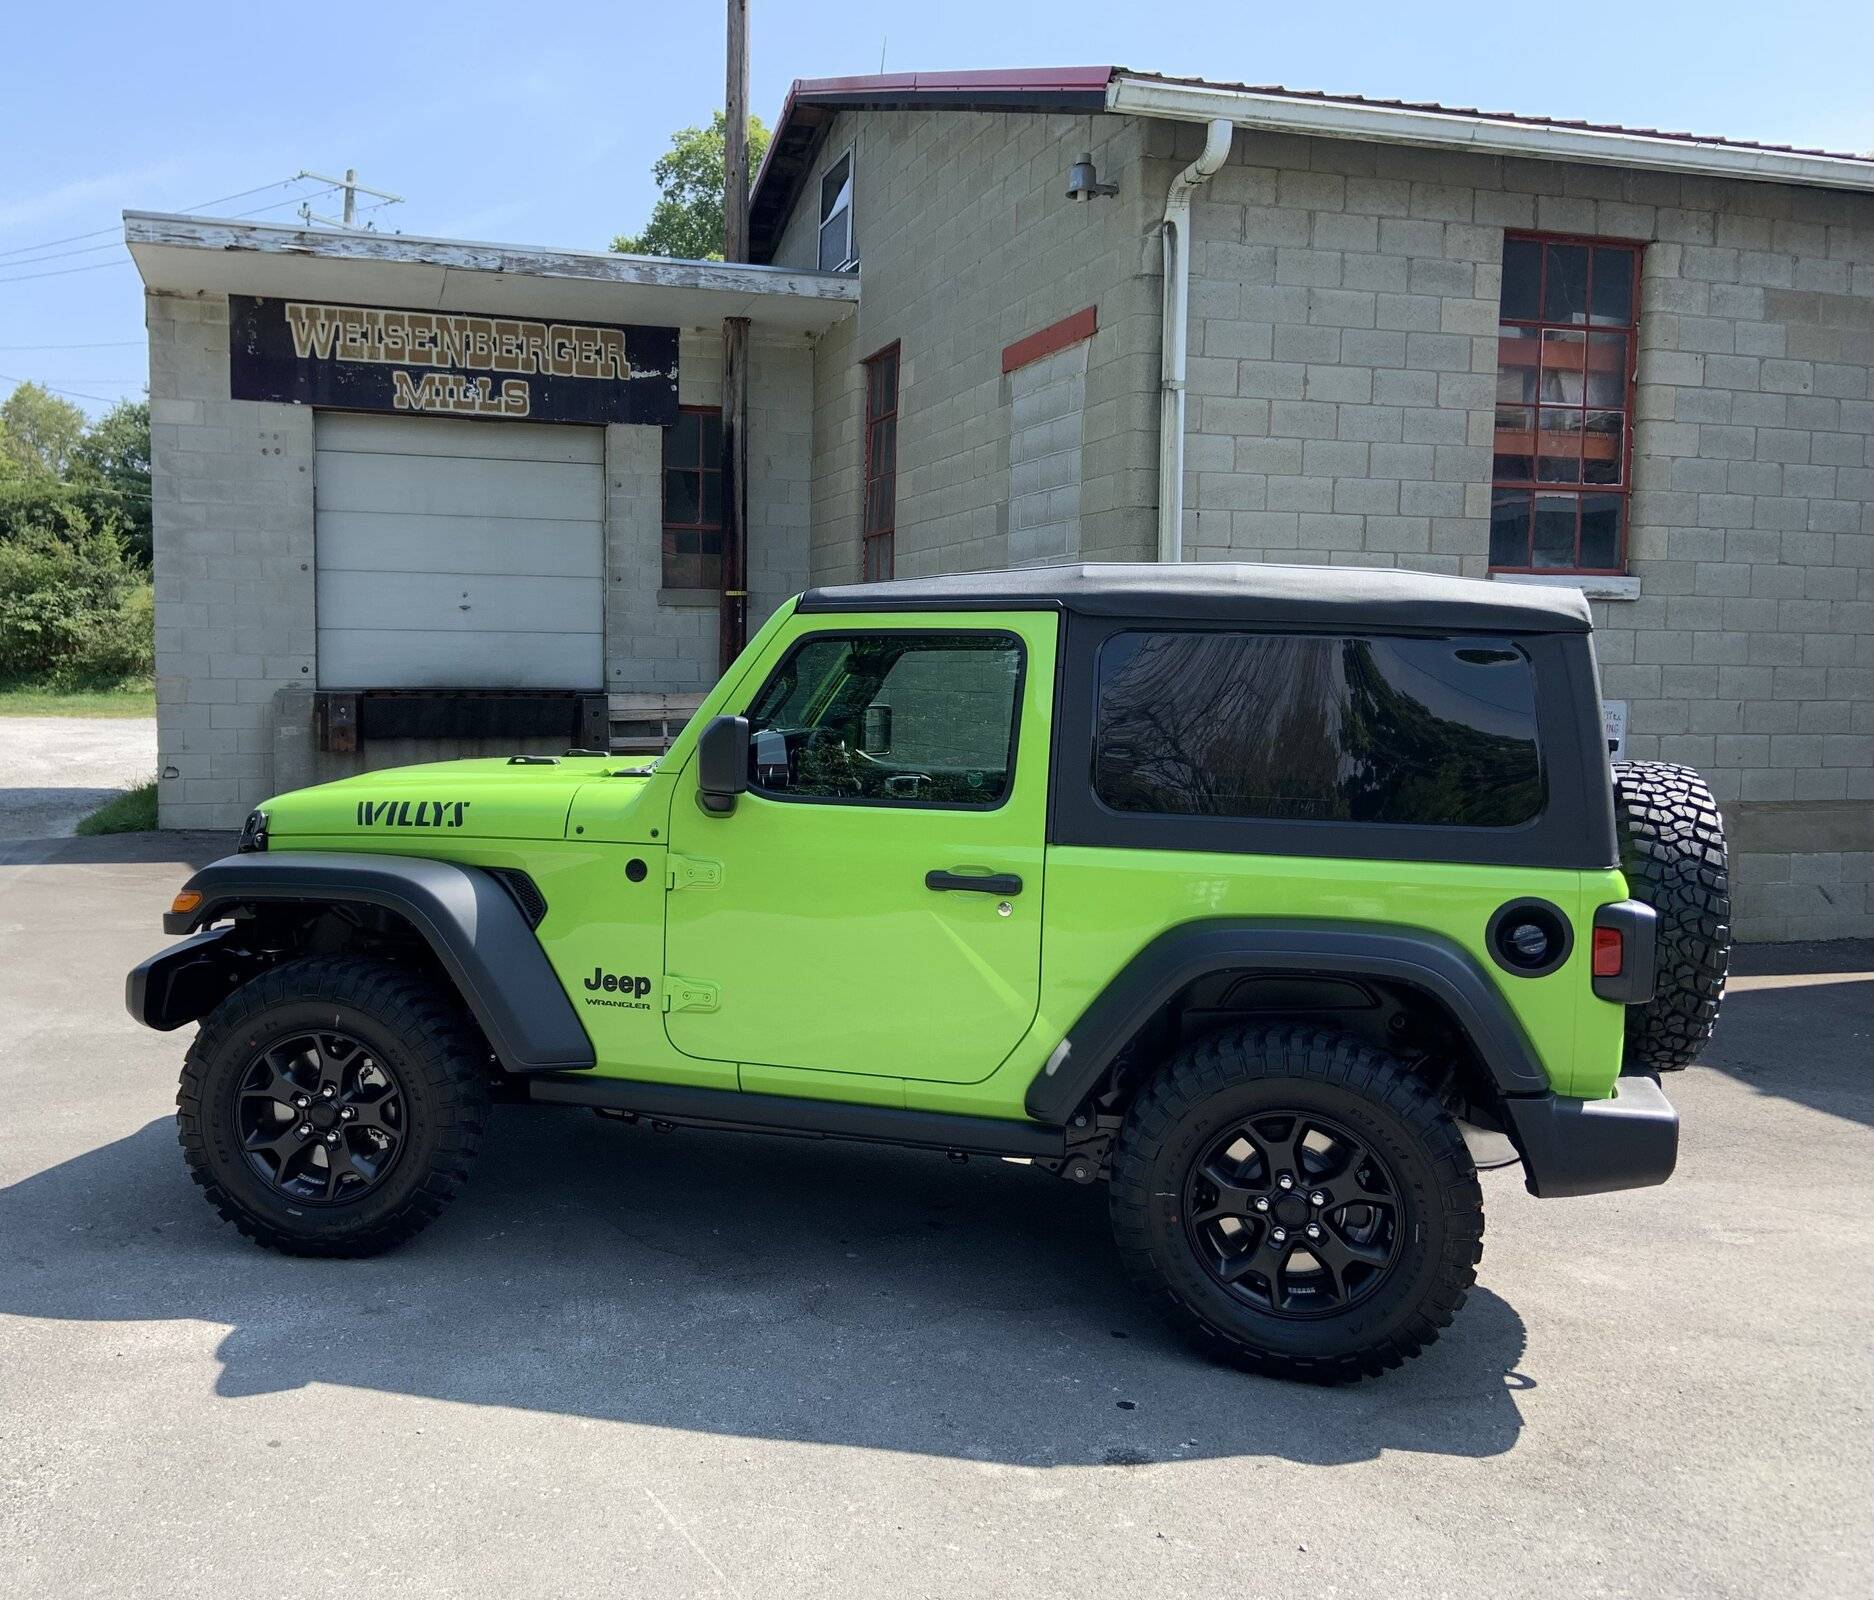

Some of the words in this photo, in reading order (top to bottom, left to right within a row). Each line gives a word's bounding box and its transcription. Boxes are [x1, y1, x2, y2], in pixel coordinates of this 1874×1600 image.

[285, 303, 630, 380] WEISENBERGER
[393, 371, 530, 417] MILLS
[357, 801, 470, 827] WILLYS
[584, 967, 651, 999] Jeep
[585, 998, 651, 1010] WRANGLER
